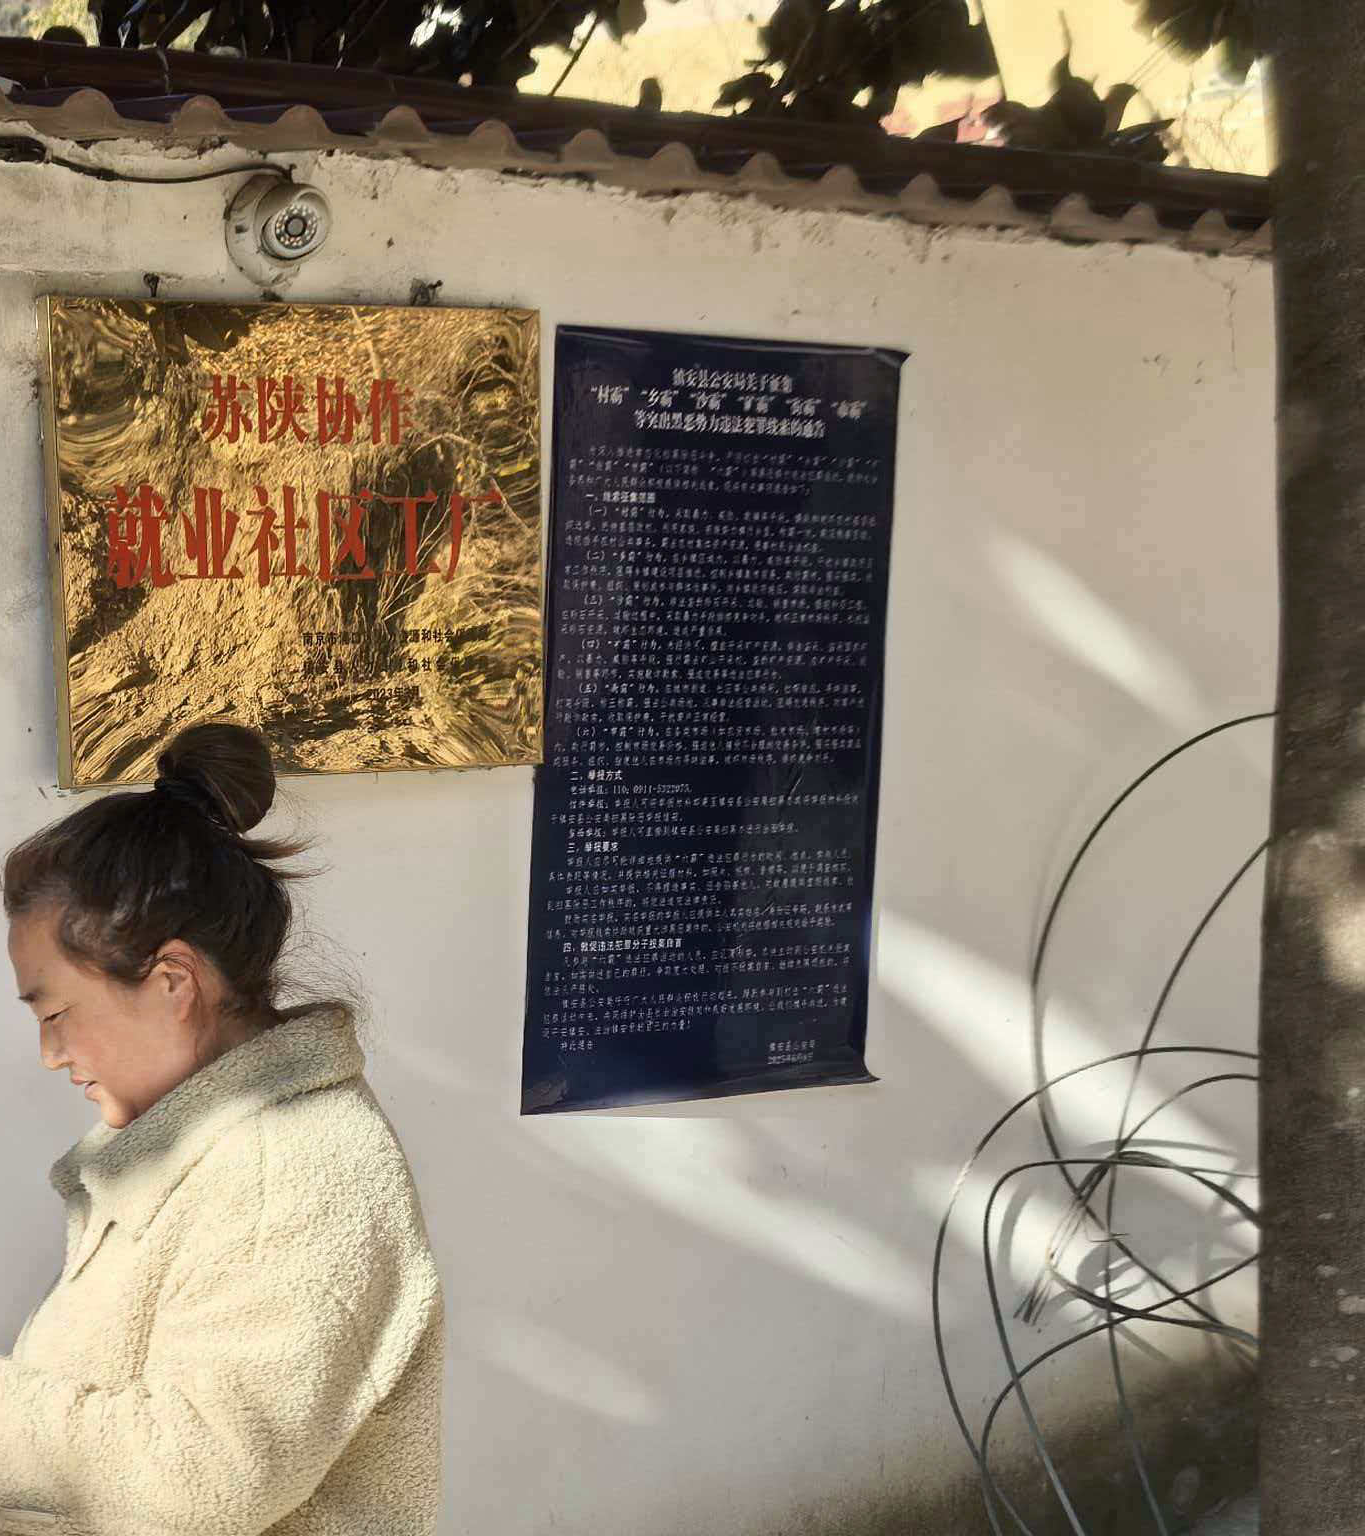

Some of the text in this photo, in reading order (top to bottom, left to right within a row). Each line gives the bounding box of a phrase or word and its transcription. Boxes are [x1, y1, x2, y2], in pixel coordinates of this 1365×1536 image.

[201, 373, 415, 448] 苏陕协作
[106, 482, 503, 590] 就业社区工厂
